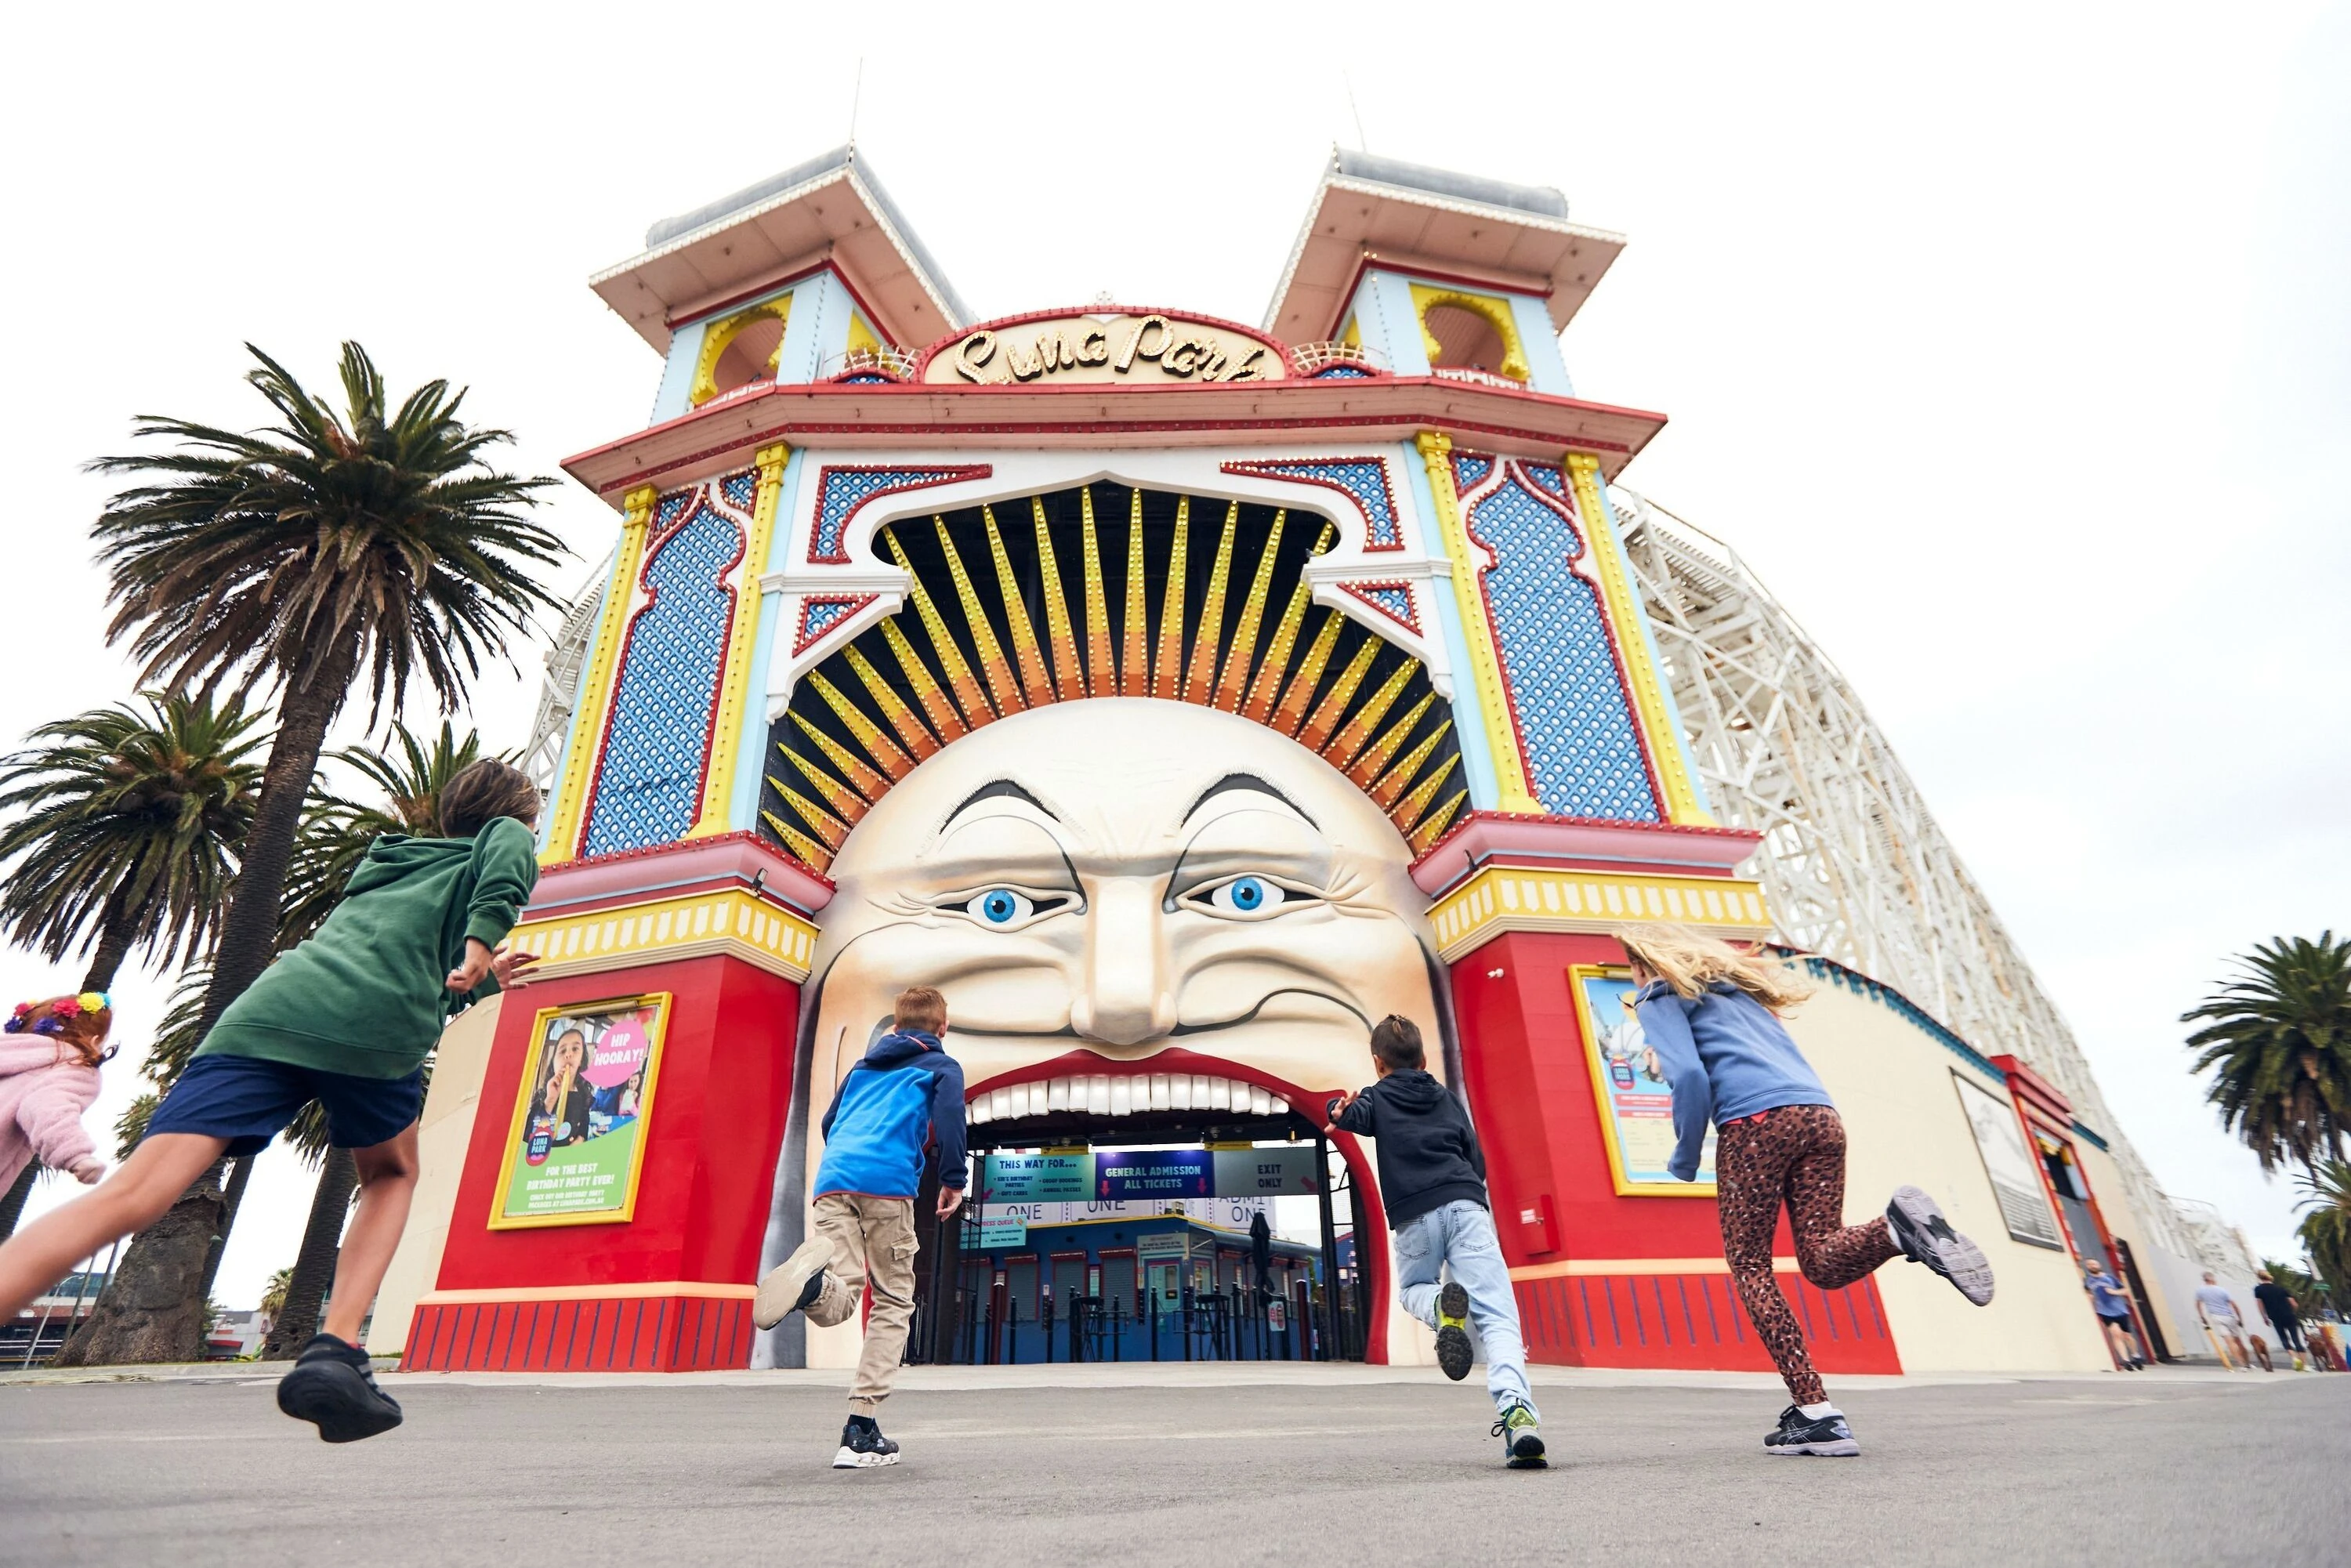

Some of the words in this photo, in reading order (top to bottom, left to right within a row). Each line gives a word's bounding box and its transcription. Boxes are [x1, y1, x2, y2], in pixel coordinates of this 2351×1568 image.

[954, 327, 1110, 386] Luna
[1114, 314, 1266, 382] Park
[610, 1033, 631, 1047] HIP
[594, 1048, 643, 1066] HOORAY!
[531, 1145, 546, 1153] PARK
[545, 1166, 560, 1176] FOR
[562, 1164, 577, 1175] THE
[578, 1163, 598, 1174] BEST
[1024, 1160, 1045, 1168] WAY
[1048, 1159, 1077, 1168] FOR...
[1257, 1164, 1281, 1174] EXIT
[1105, 1167, 1147, 1177] GENERAL
[1150, 1165, 1201, 1175] ADMISSION
[527, 1178, 565, 1190] BIRTHDAY
[565, 1175, 591, 1188] PARTY
[592, 1174, 614, 1186] EVER!
[1125, 1179, 1141, 1190] ALL
[1144, 1179, 1183, 1189] TICKETS
[1258, 1178, 1283, 1188] ONLY
[1007, 1204, 1042, 1220] ONE
[1088, 1200, 1126, 1212] ONE
